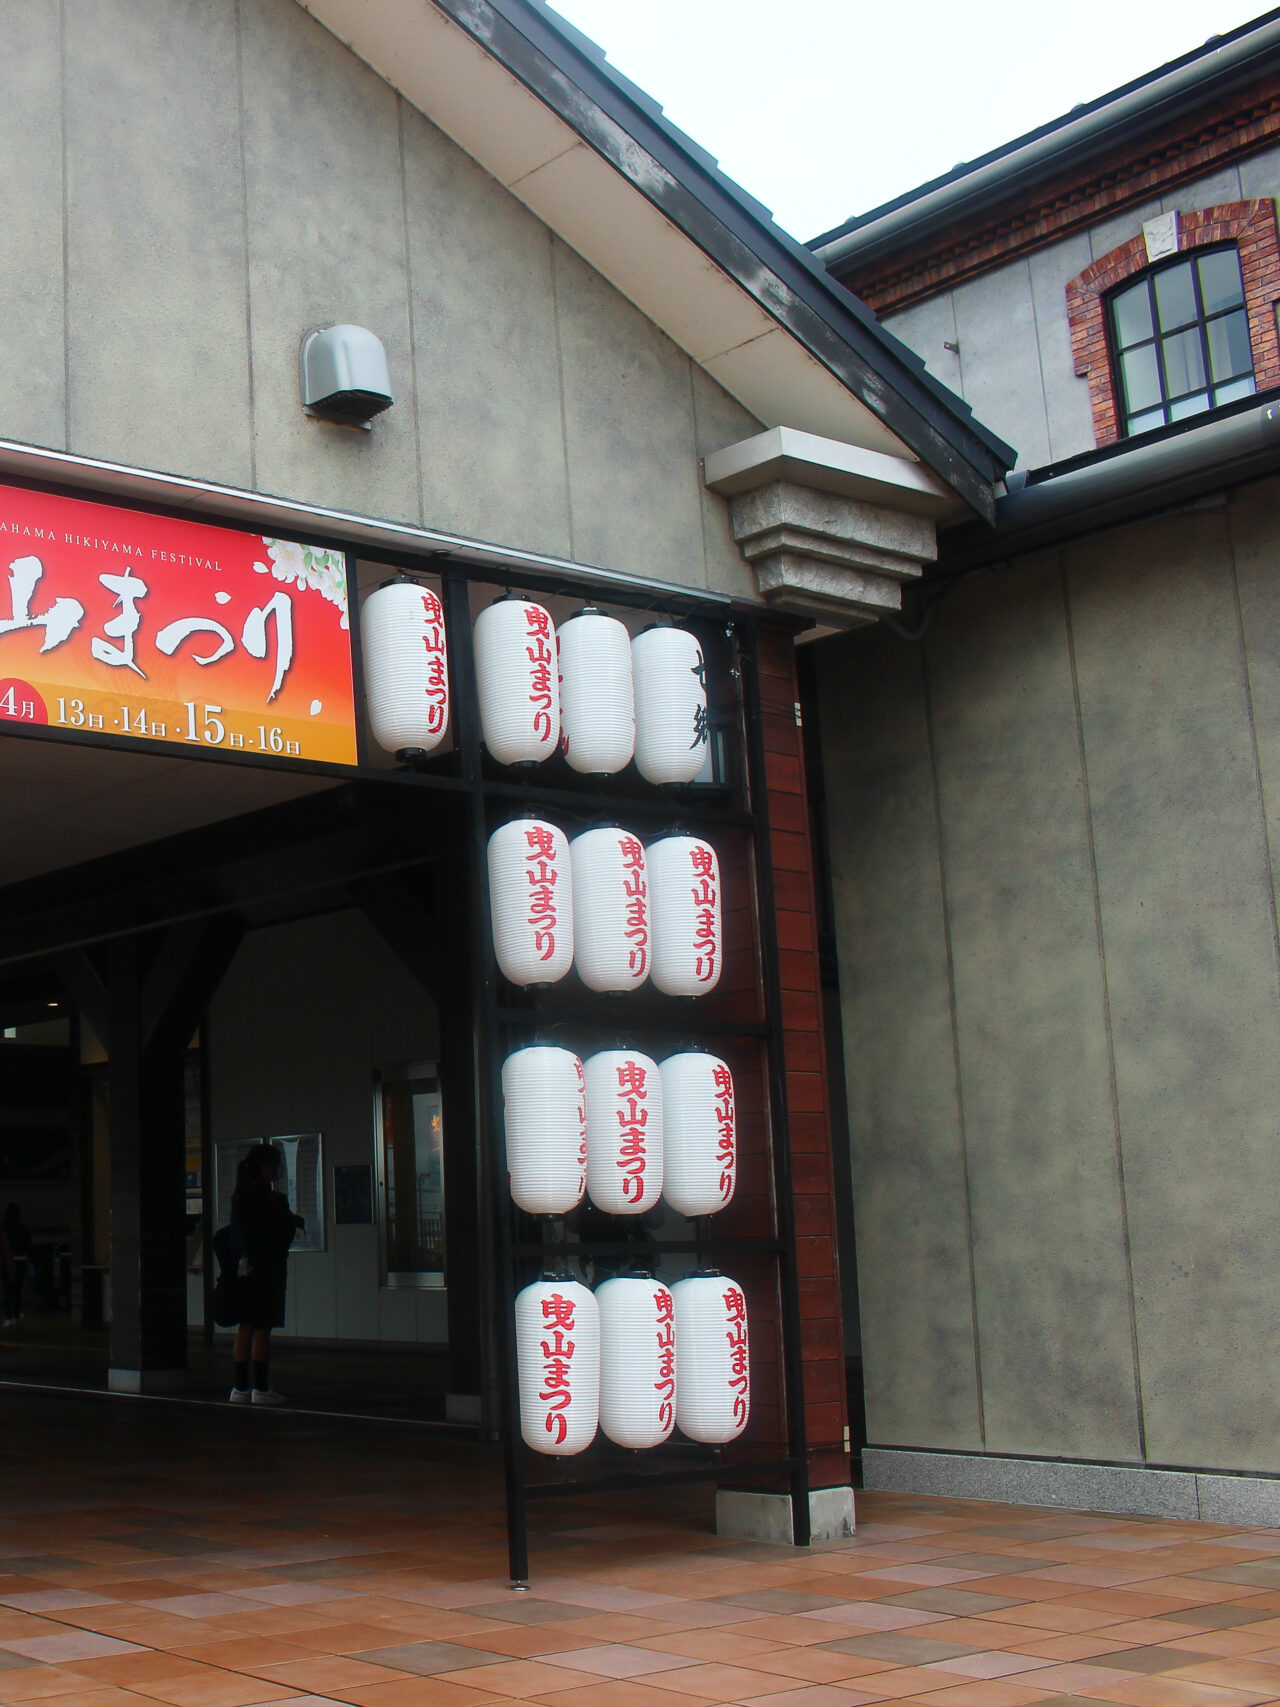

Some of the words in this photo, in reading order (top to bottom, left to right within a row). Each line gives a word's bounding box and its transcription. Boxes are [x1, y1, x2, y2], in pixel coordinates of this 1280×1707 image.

[64, 533, 143, 557] HIKIYAMA
[151, 549, 222, 572] FESTIVAL
[0, 686, 35, 719] 4月
[421, 593, 447, 733] 曳山まつり
[525, 606, 551, 741] 曳山まつり
[525, 827, 557, 960] 曳山まつり
[619, 837, 647, 976] 曳山まつり
[690, 847, 715, 981] 曳山まつり
[617, 1061, 648, 1203] 曳山まつり
[712, 1065, 733, 1199] 曳山まつり
[539, 1294, 576, 1444] 曳山まつり
[654, 1289, 675, 1431] 曳山まつり
[723, 1288, 747, 1427] 曳山まつり
